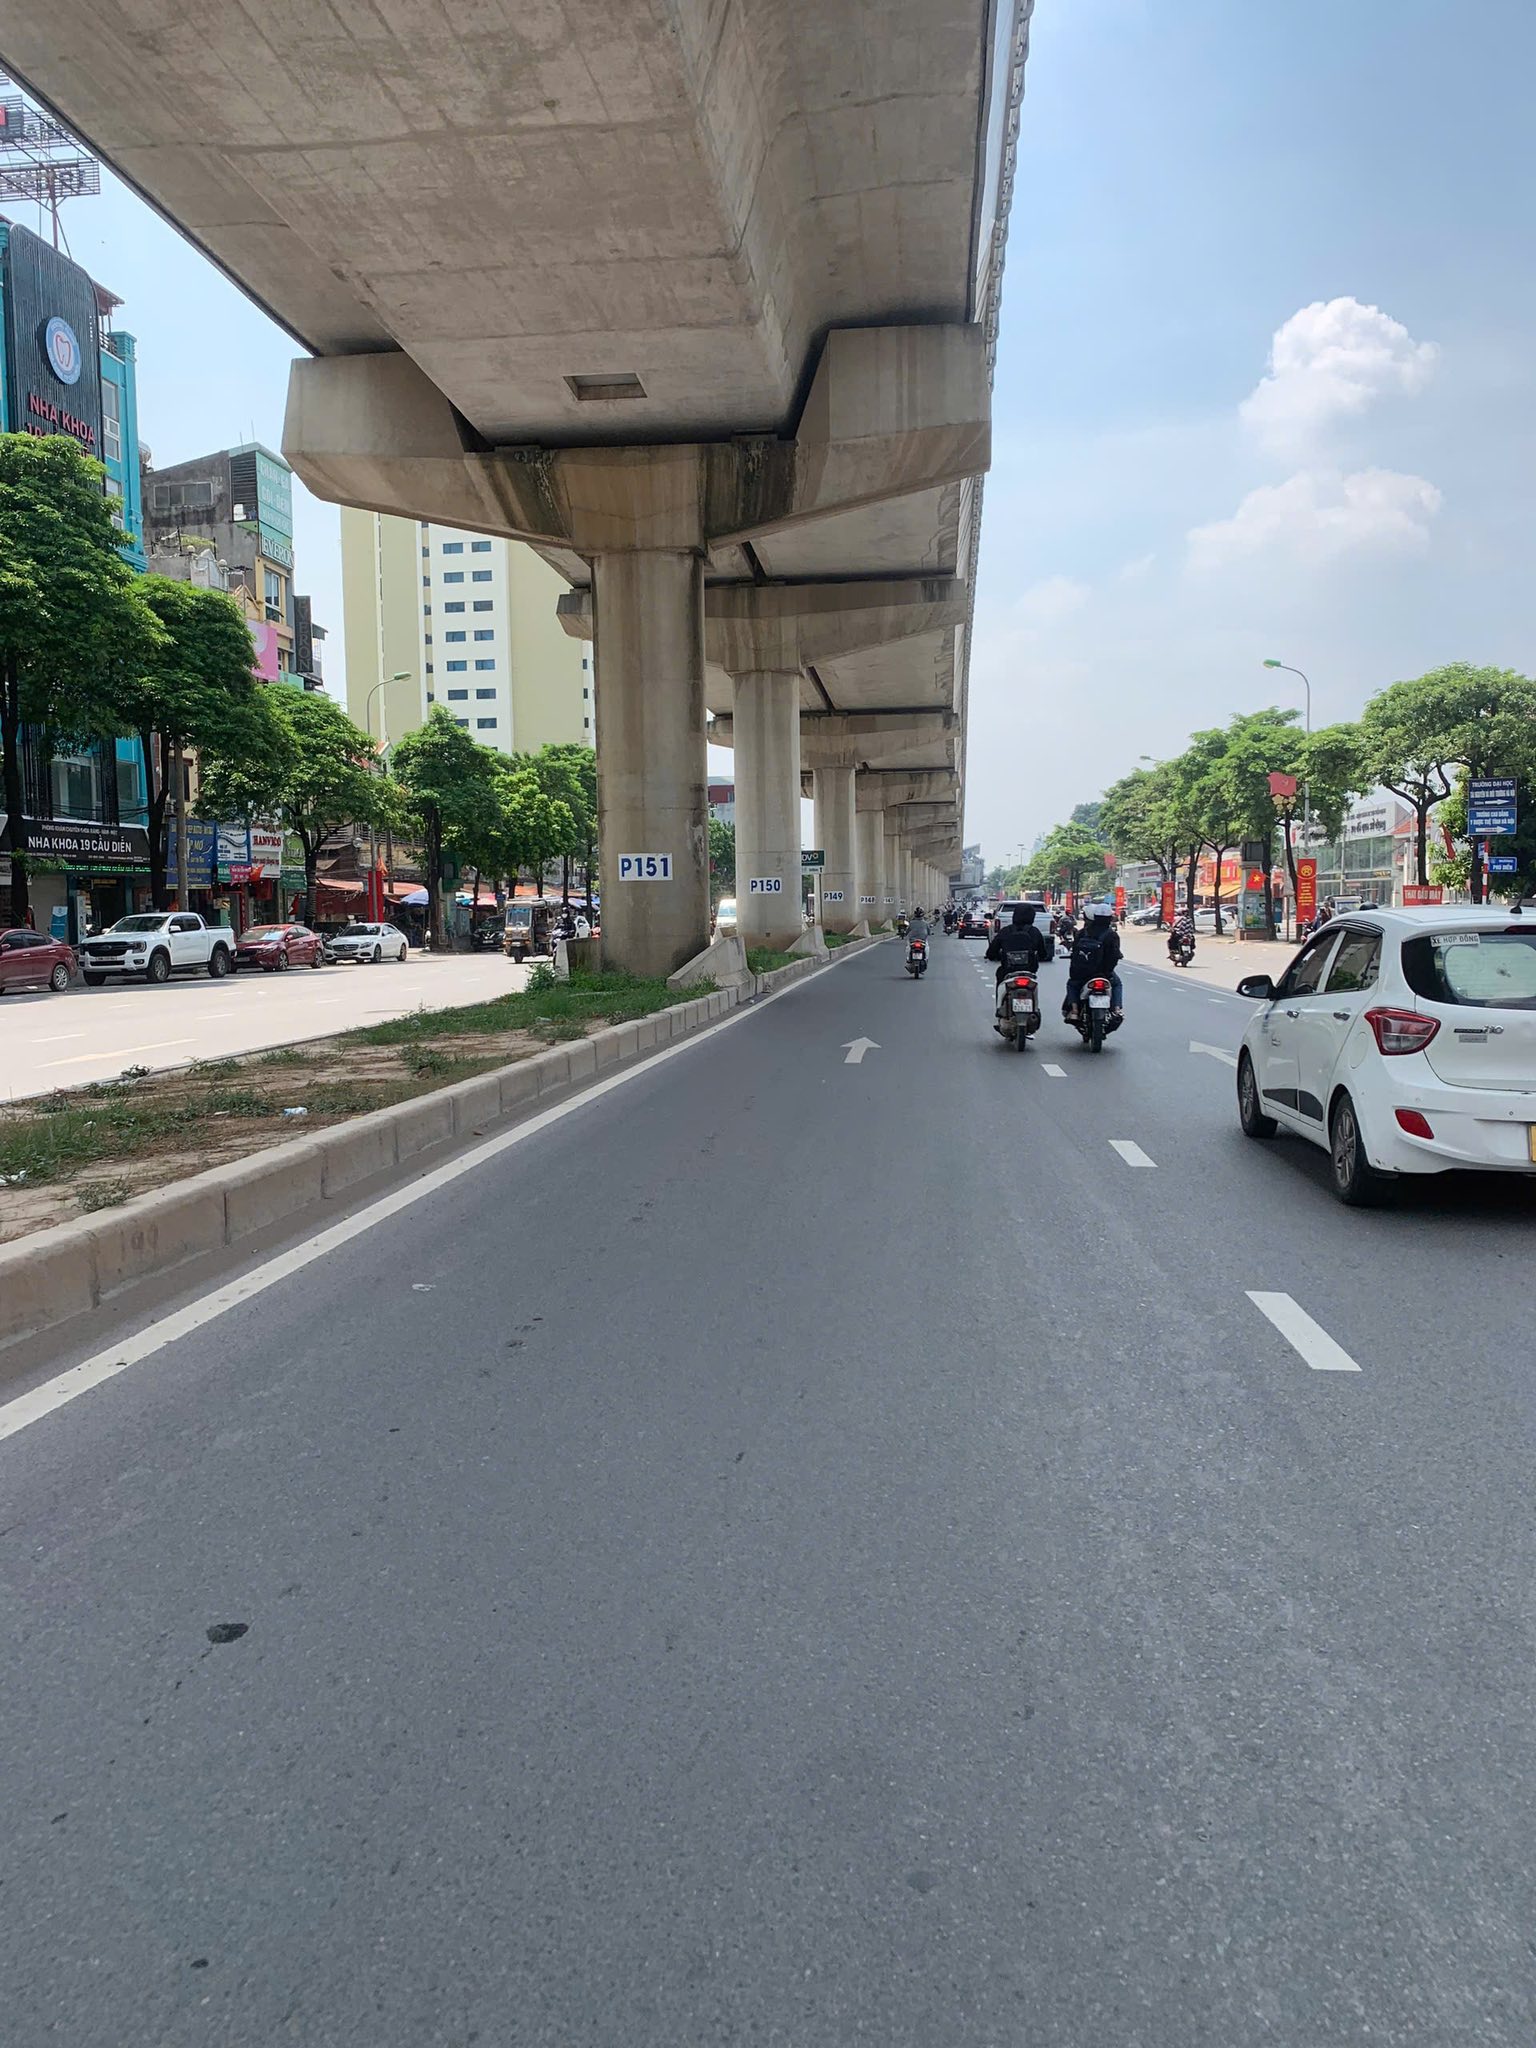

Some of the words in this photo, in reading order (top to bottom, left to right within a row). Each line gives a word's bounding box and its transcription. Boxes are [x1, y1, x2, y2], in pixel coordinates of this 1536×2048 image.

[28, 392, 58, 425] NHA
[61, 410, 96, 446] KHOA
[28, 836, 50, 849] NHA
[52, 837, 79, 851] KHOA
[80, 839, 90, 851] 19
[92, 834, 110, 852] CẦU
[253, 835, 281, 848] HANVICO
[621, 857, 669, 877] P151
[750, 879, 781, 892] P150
[823, 892, 843, 900] P149
